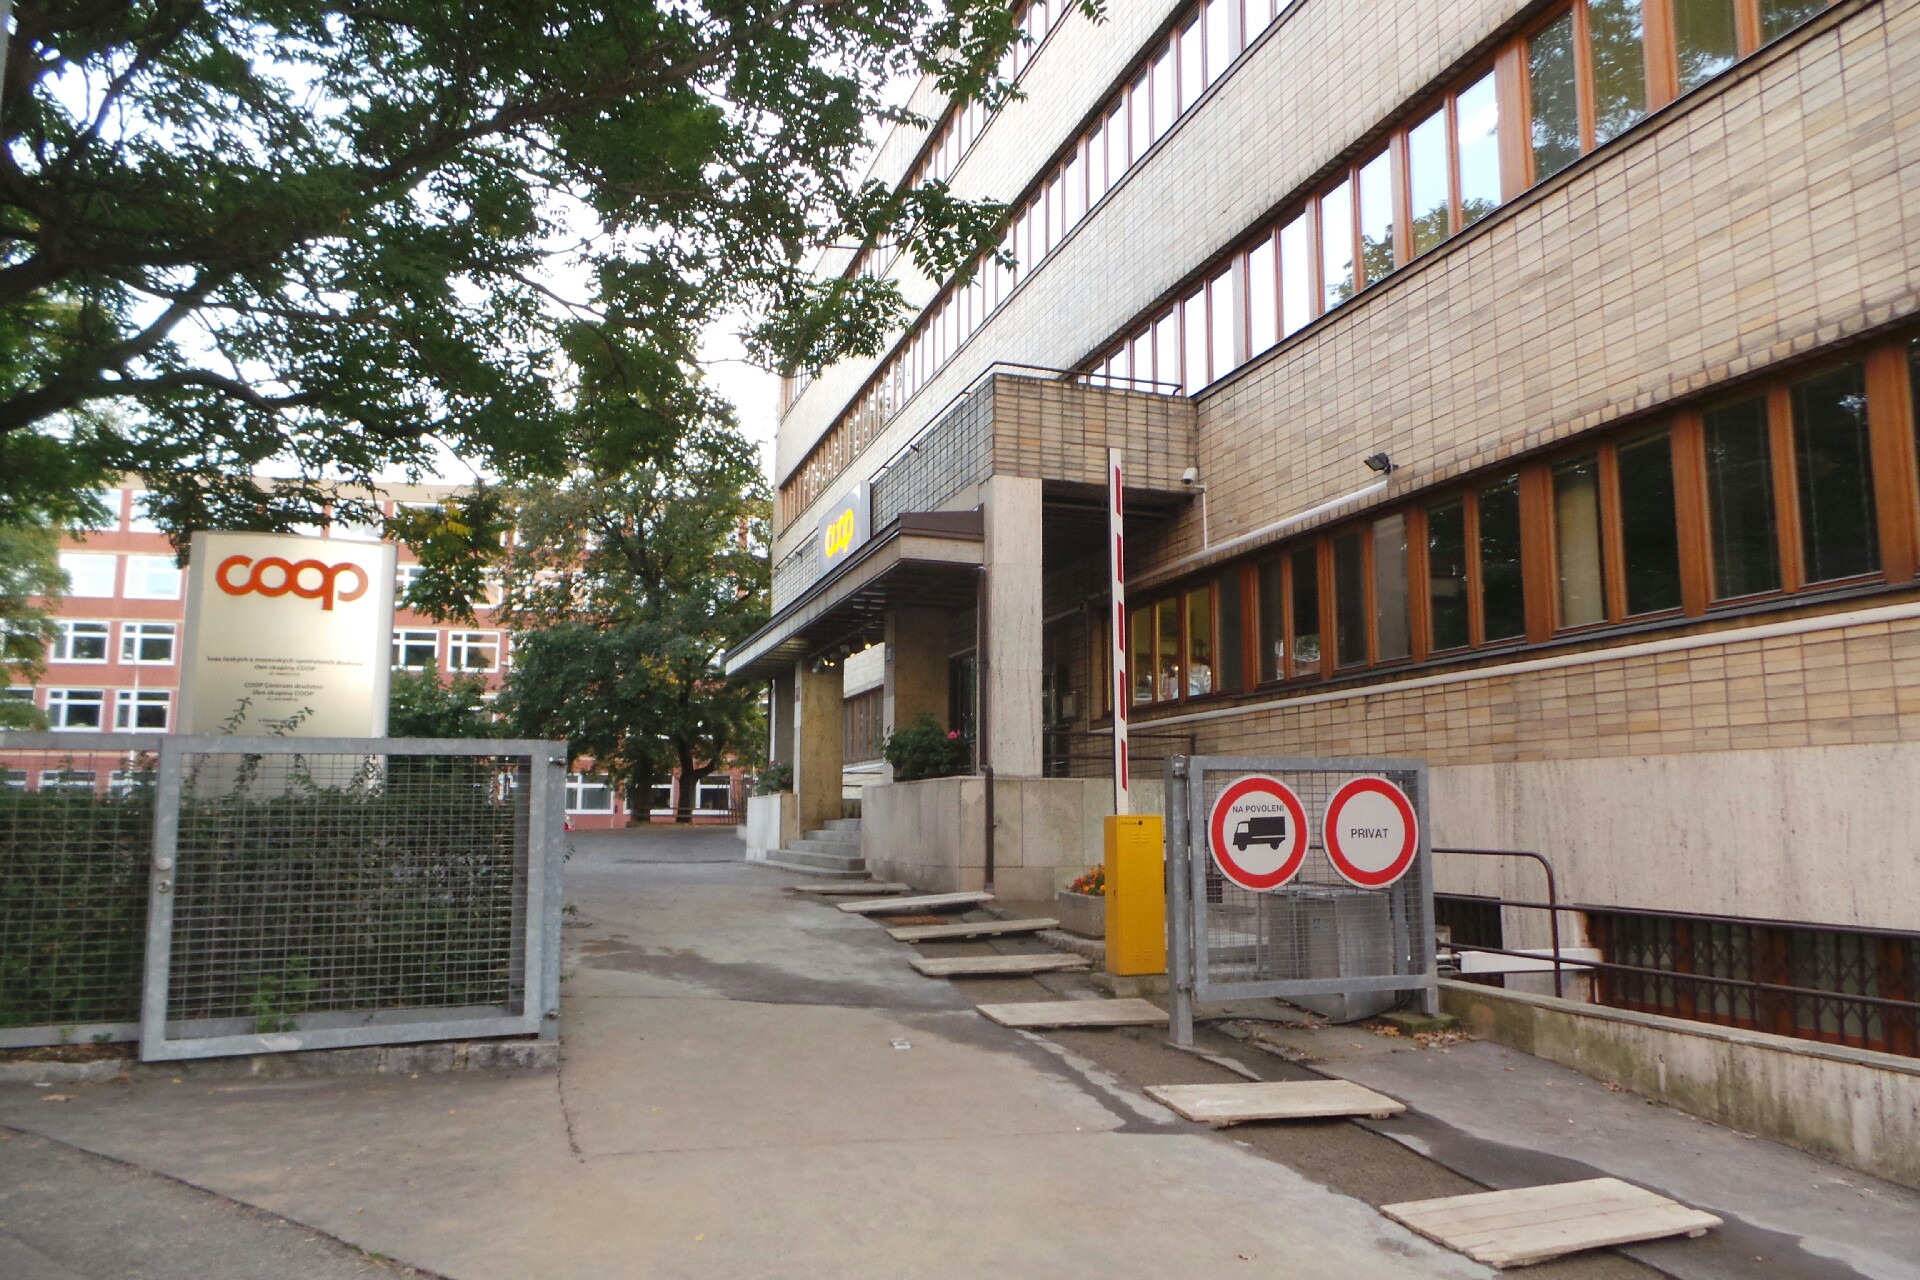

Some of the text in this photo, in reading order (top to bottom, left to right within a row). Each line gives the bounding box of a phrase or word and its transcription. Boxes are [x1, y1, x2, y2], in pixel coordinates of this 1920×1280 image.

[215, 554, 369, 611] coop
[1232, 805, 1244, 813] NA
[1351, 828, 1389, 839] PRIVAT
